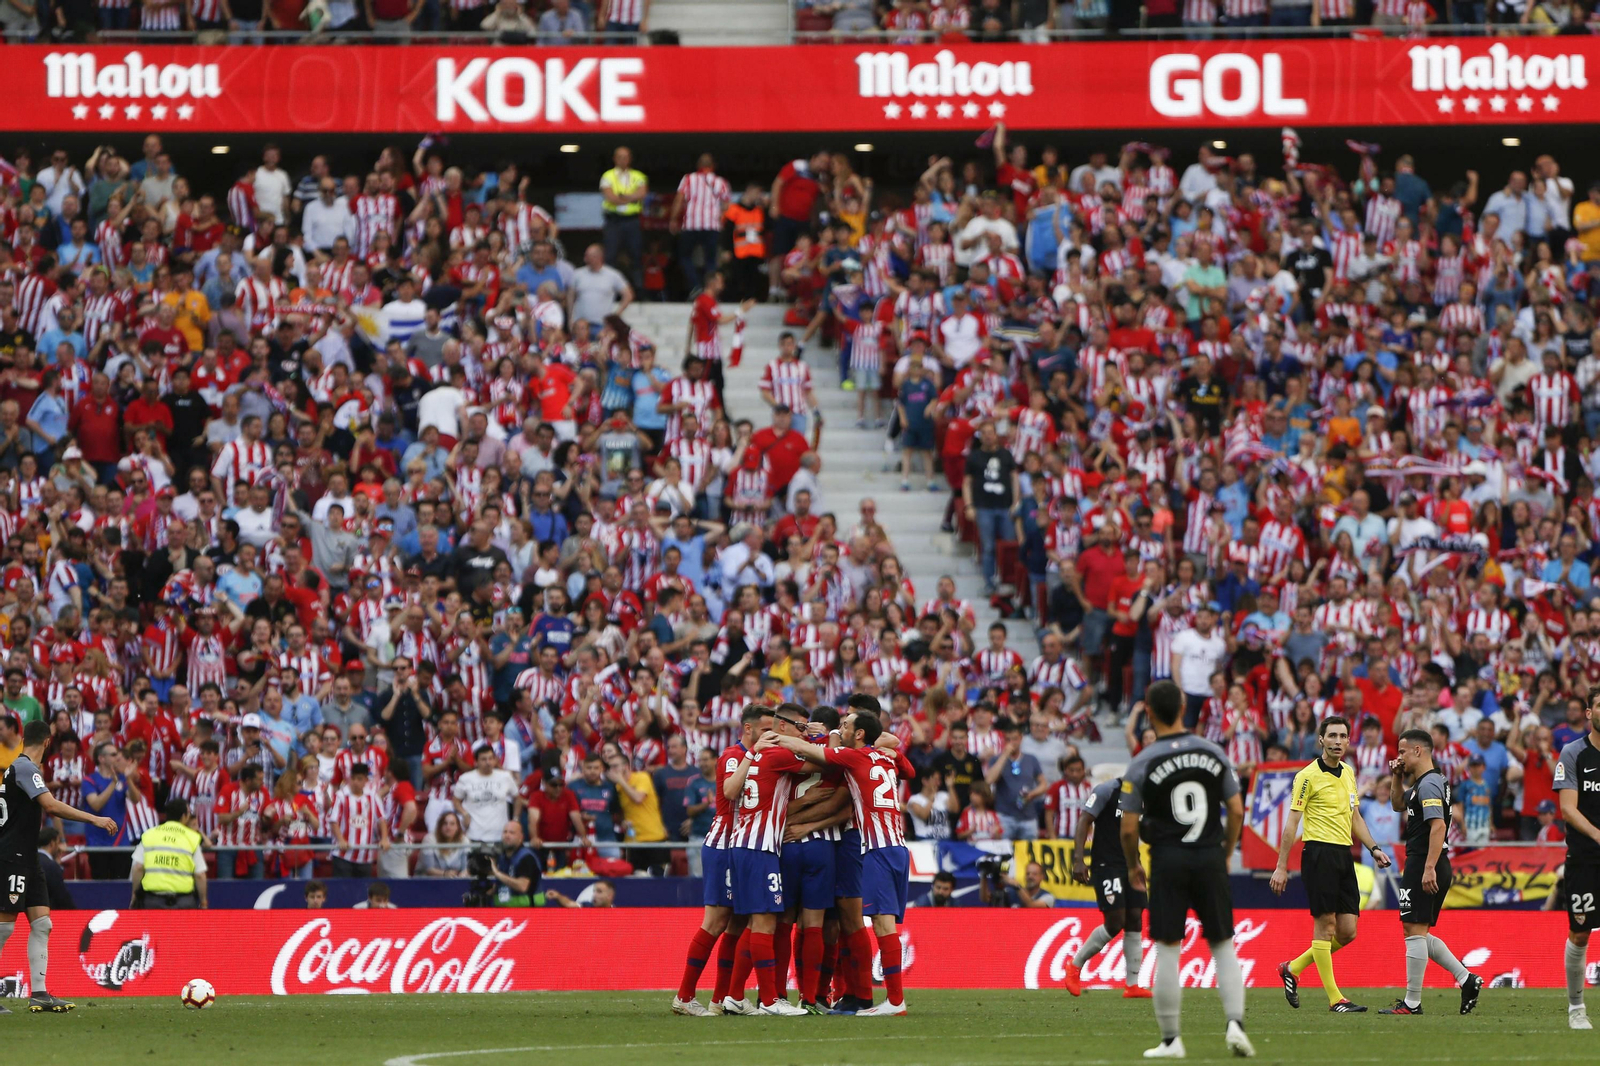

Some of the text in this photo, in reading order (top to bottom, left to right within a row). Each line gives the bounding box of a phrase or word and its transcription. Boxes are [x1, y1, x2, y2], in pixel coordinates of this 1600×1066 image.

[44, 52, 221, 98] Mahou
[437, 57, 644, 122] KOKE
[857, 50, 1033, 97] Mahou
[1150, 53, 1307, 117] GOL
[1410, 43, 1587, 91] Mahou
[739, 766, 760, 810] 5
[1171, 781, 1208, 843] 9
[154, 854, 180, 867] ARIETE
[8, 874, 26, 894] 15
[1102, 877, 1123, 896] 24
[1571, 892, 1596, 913] 22
[270, 917, 529, 994] Coca-Cola
